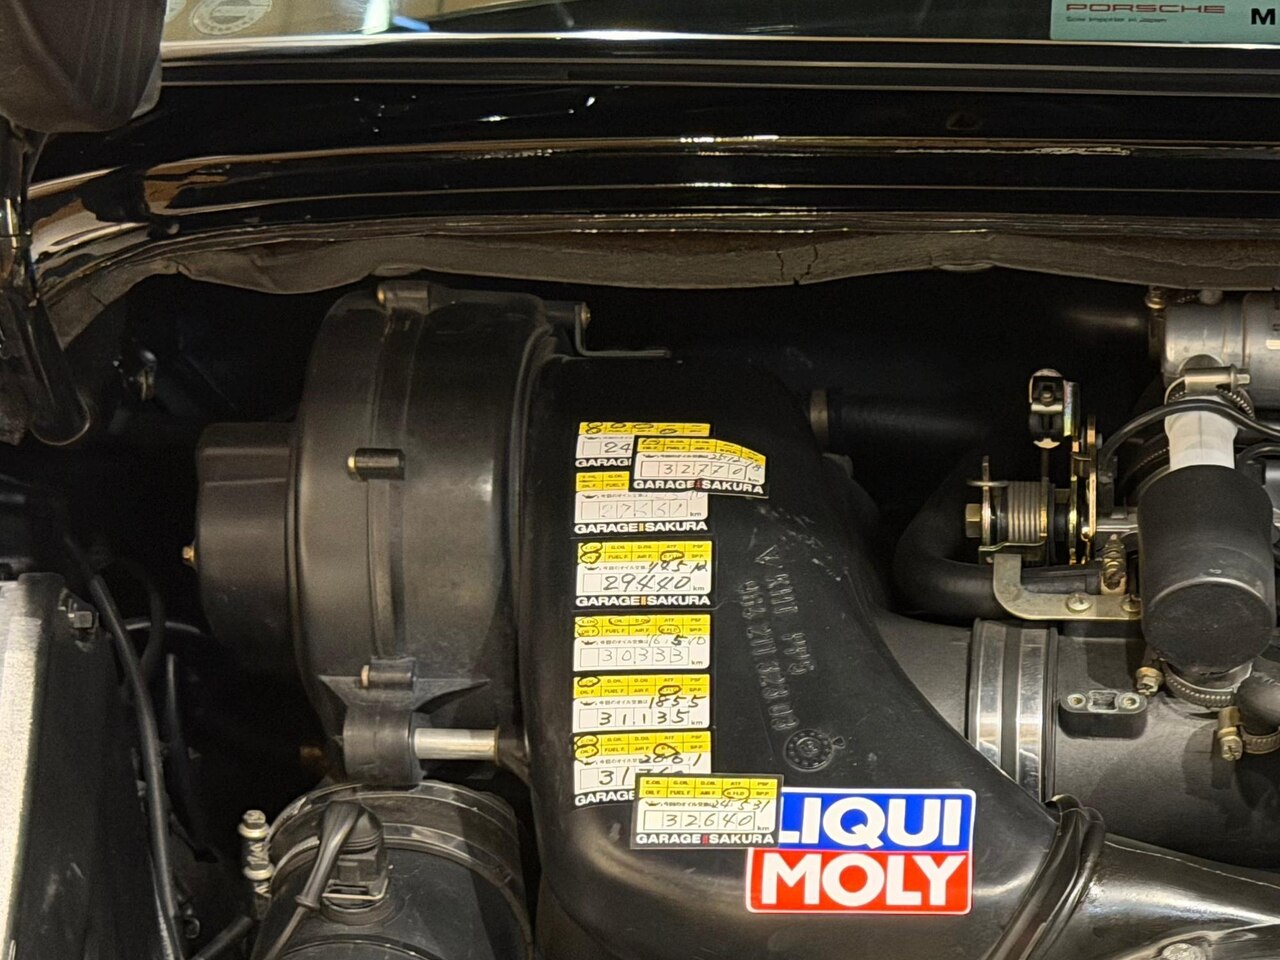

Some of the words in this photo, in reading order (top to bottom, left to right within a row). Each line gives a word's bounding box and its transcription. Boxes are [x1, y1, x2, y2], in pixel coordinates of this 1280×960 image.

[1066, 4, 1225, 13] PORSCHE
[575, 458, 631, 467] GARAG
[634, 480, 696, 489] GARAGE
[701, 481, 764, 493] SAKURA
[574, 523, 638, 533] GARAGE
[645, 522, 708, 531] SAKURA
[576, 597, 640, 606] GARAGE
[647, 596, 710, 605] SAKURA
[575, 791, 634, 806] GARAGE
[636, 834, 701, 844] GARAGE
[709, 834, 774, 843] SAKURA
[761, 853, 966, 906] MOLY
